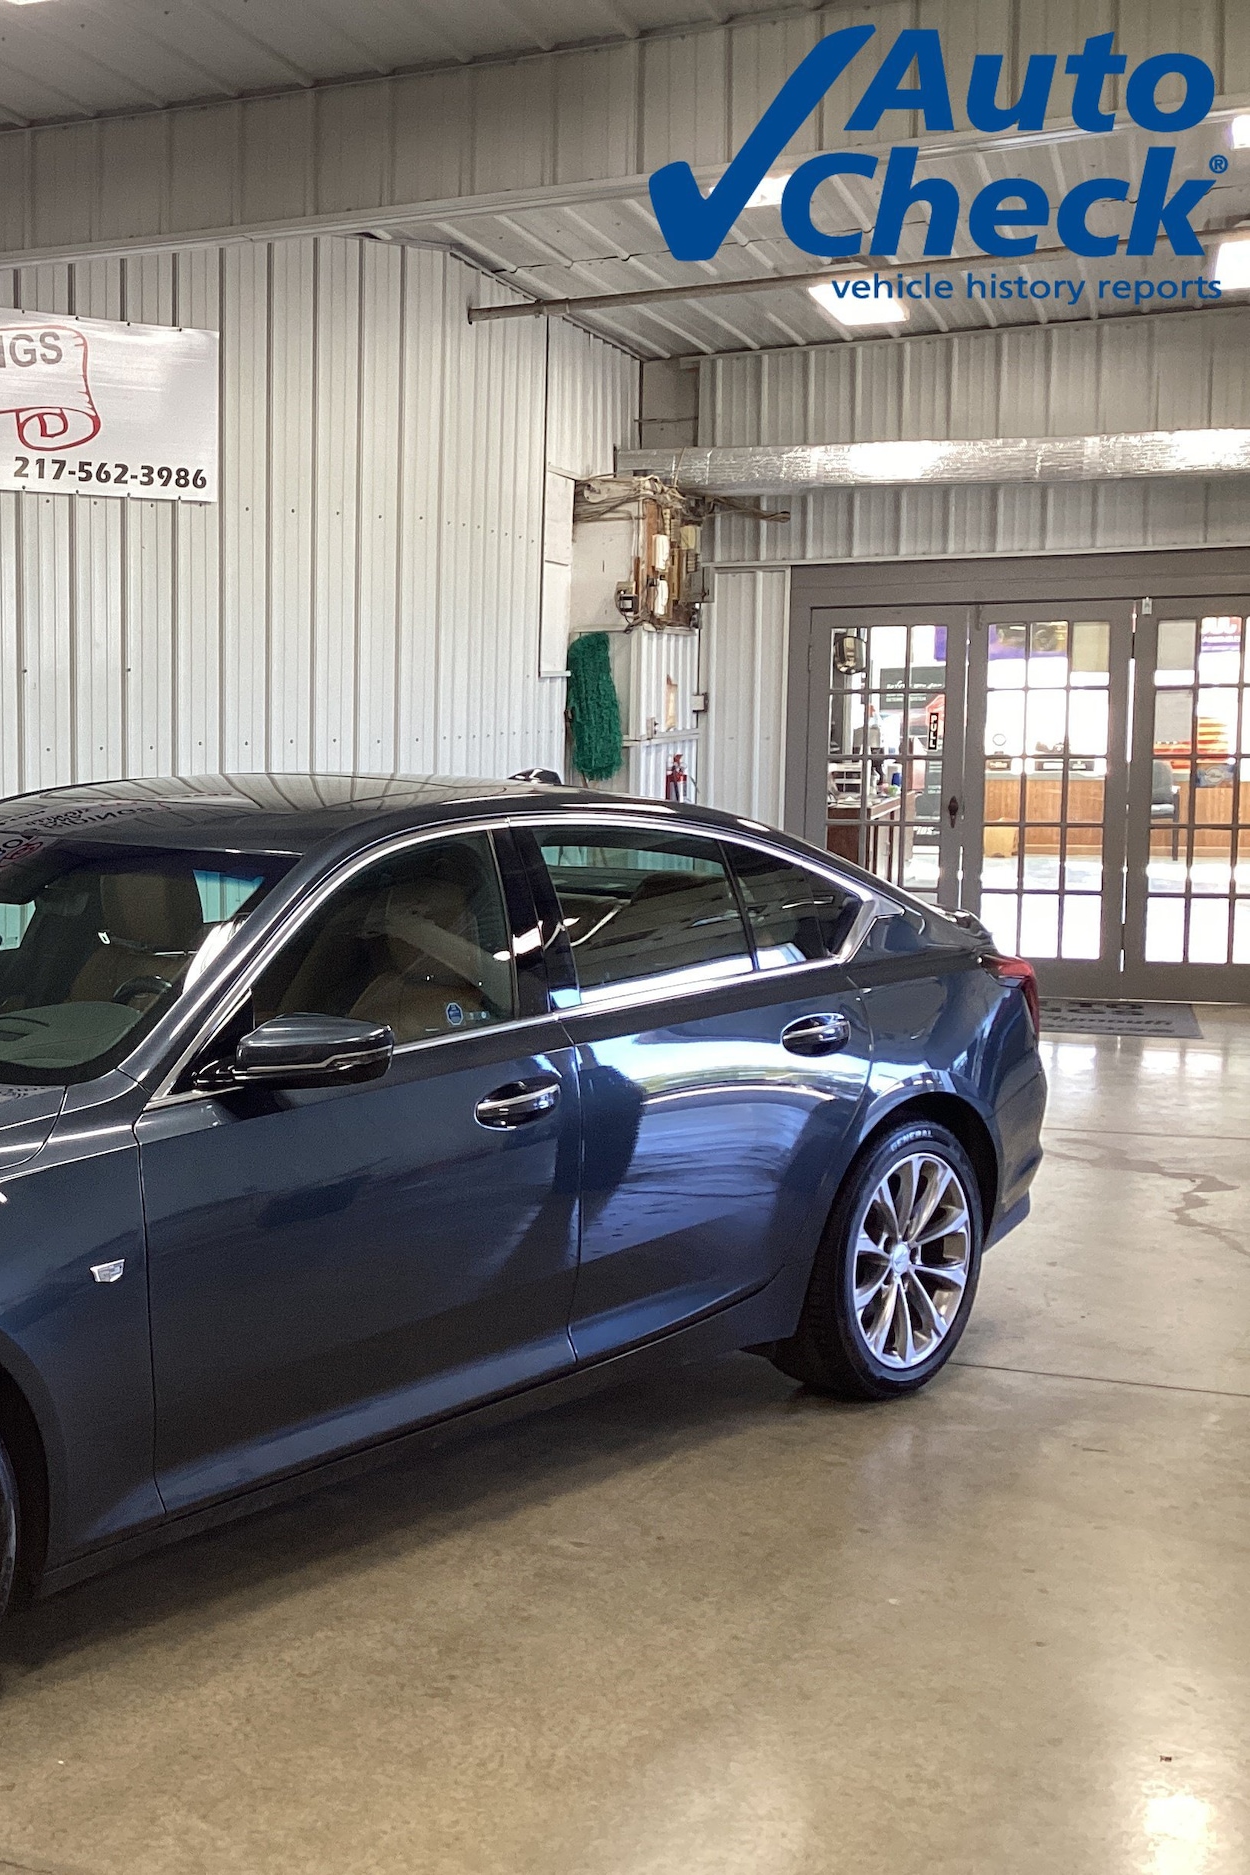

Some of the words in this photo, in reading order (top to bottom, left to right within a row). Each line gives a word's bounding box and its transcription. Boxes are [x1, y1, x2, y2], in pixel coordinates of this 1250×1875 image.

[14, 456, 208, 490] 217-562-3986
[930, 714, 938, 748] PULL
[890, 1129, 933, 1152] GENERAL
